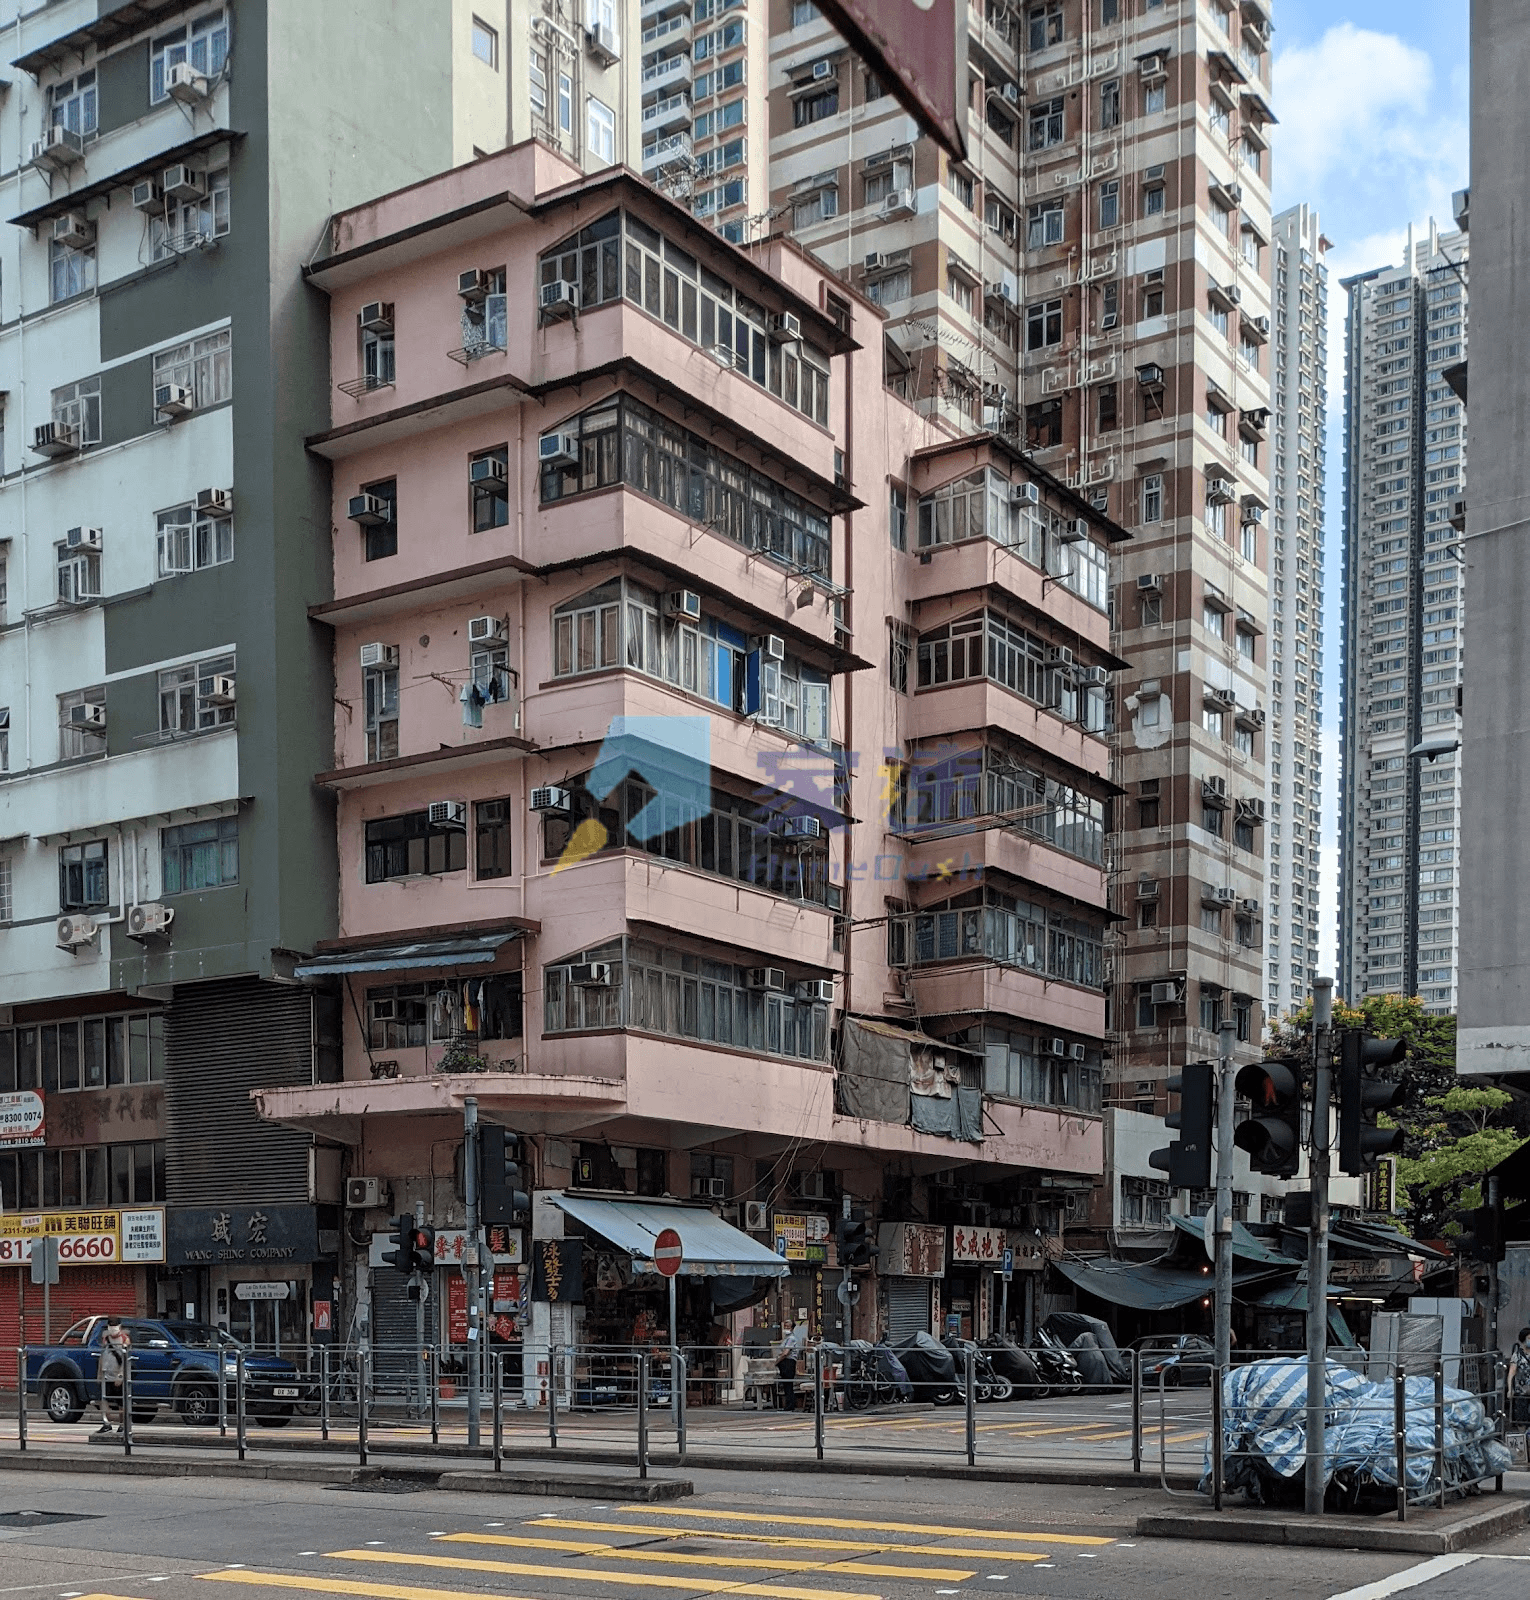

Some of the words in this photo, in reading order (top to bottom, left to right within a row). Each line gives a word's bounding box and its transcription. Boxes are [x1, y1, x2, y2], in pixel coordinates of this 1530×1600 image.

[4, 1113, 22, 1123] 8300
[24, 1111, 42, 1122] 0074
[65, 1215, 116, 1231] 美聯旺舖
[59, 1237, 114, 1258] 6660
[185, 1250, 212, 1260] WANG
[218, 1249, 245, 1259] SHING
[250, 1247, 296, 1258] COMPANY
[1004, 1251, 1012, 1269] P
